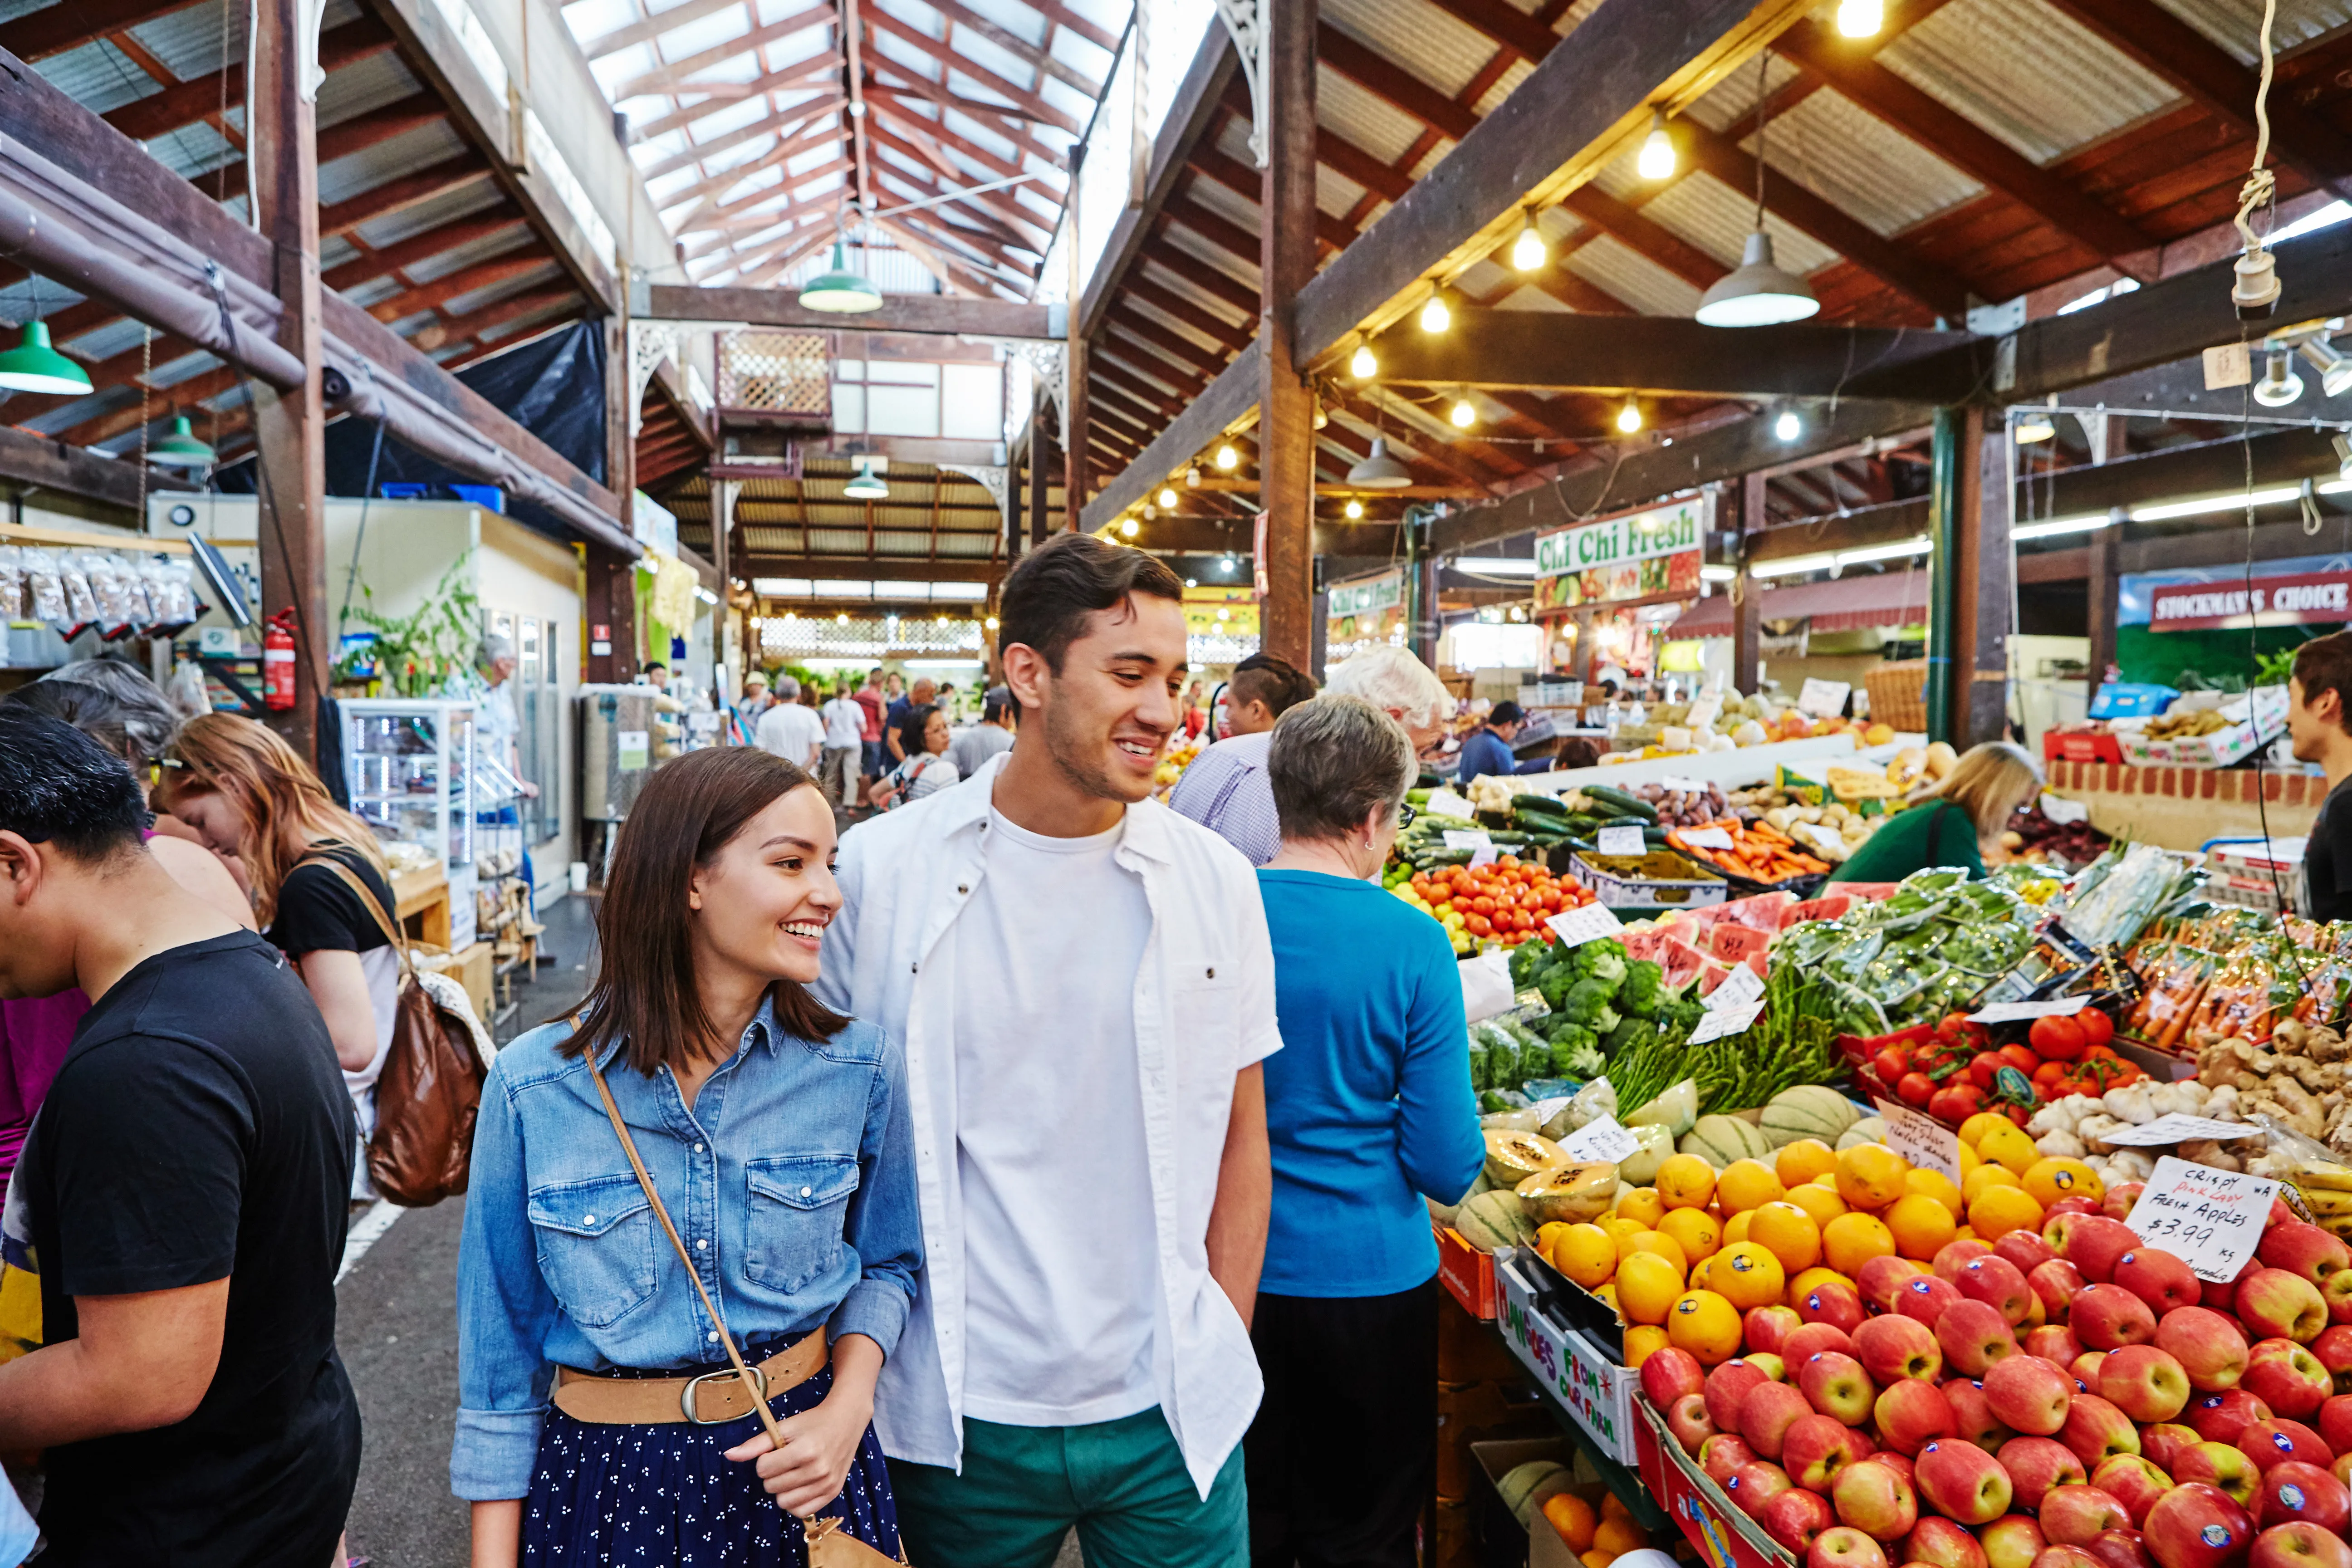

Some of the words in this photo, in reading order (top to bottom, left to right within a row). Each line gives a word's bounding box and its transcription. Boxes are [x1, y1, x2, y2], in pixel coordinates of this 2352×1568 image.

[1579, 524, 1618, 564] Chi
[1627, 507, 1695, 556] Fresh
[2155, 589, 2265, 620] STOCKMAN'S
[2273, 582, 2349, 611] CHOICE
[2185, 1170, 2240, 1191] CRISPY
[2149, 1193, 2190, 1210] FRESH
[2209, 1191, 2244, 1207] LADY
[2147, 1219, 2214, 1248] $3.99
[1497, 1278, 1557, 1382] MANGOES
[1563, 1348, 1600, 1400] FROM
[1559, 1374, 1584, 1415] OUR
